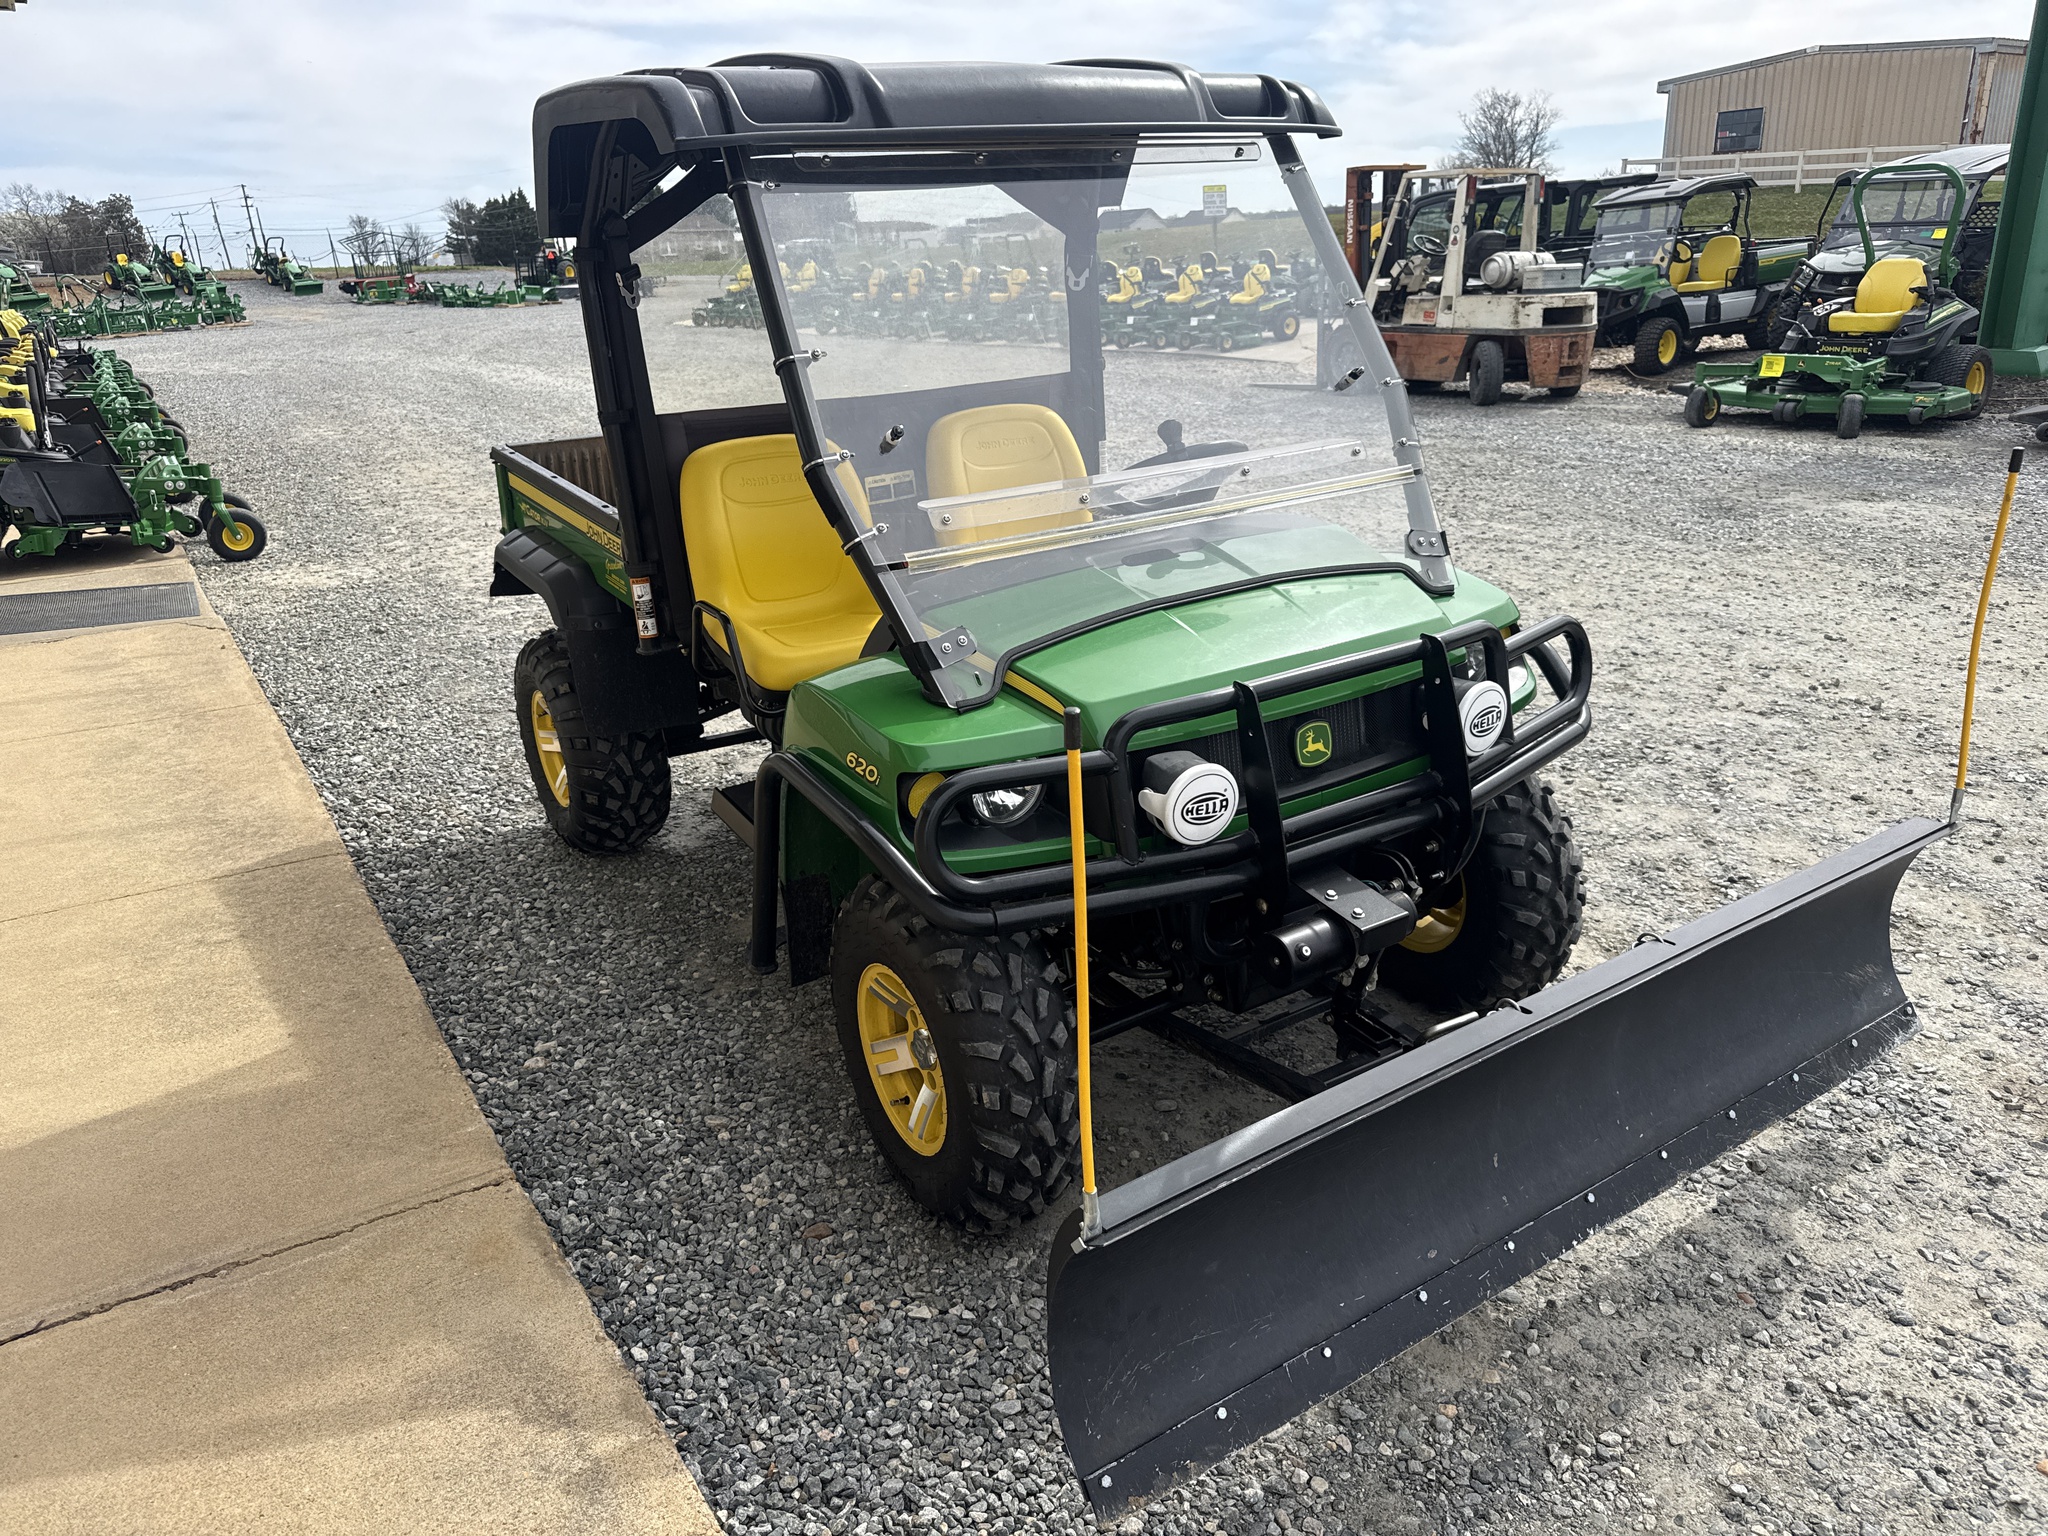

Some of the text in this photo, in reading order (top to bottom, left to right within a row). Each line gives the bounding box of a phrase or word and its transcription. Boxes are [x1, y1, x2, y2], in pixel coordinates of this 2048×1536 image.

[1346, 199, 1354, 244] NISSAN
[1841, 346, 1869, 354] DEERE
[976, 437, 1036, 450] JOHN DEERE
[739, 471, 802, 487] JOHN DEER
[586, 521, 622, 557] JOHN DEER
[1475, 710, 1502, 730] HELLA
[1185, 797, 1229, 817] HELLA
